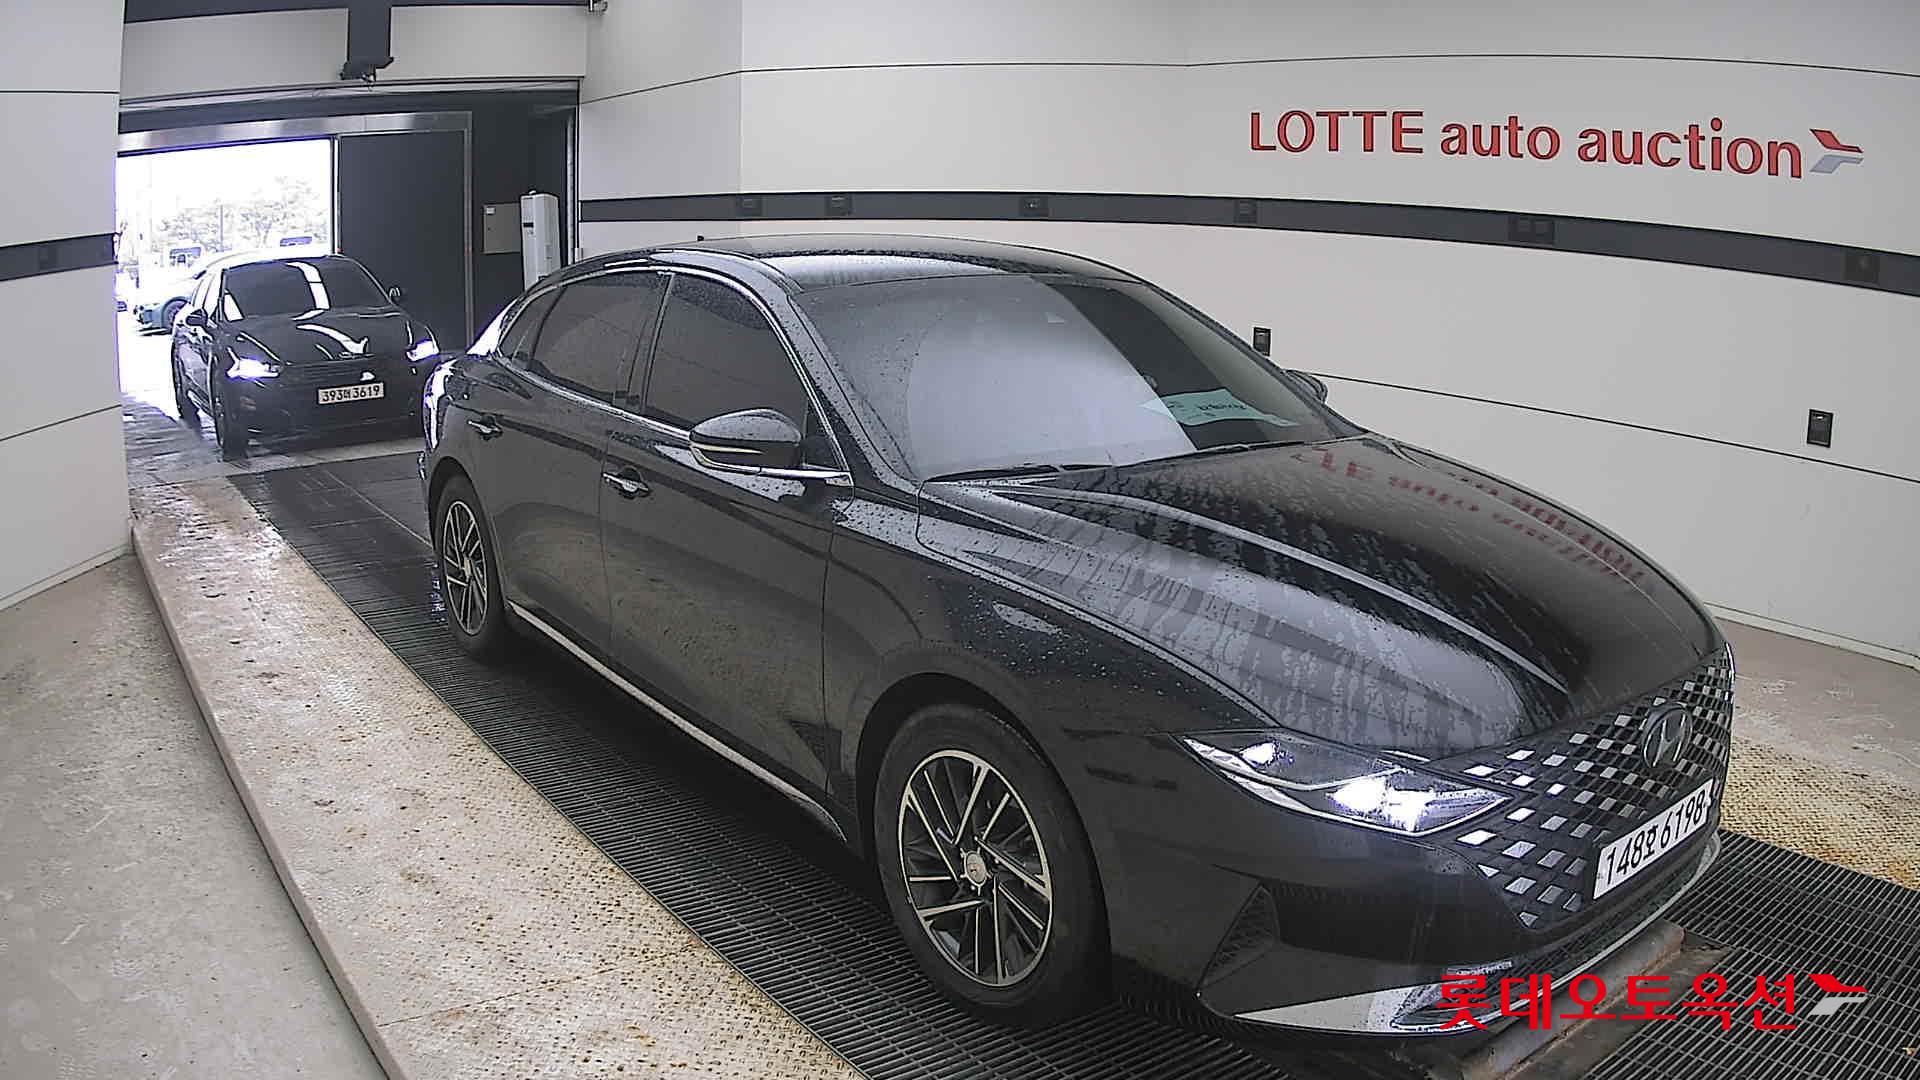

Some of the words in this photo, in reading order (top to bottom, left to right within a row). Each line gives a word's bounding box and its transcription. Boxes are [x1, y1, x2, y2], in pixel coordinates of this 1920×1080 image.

[1249, 110, 1424, 154] LOTTE
[1440, 115, 1561, 160] auto
[1577, 117, 1802, 179] auction
